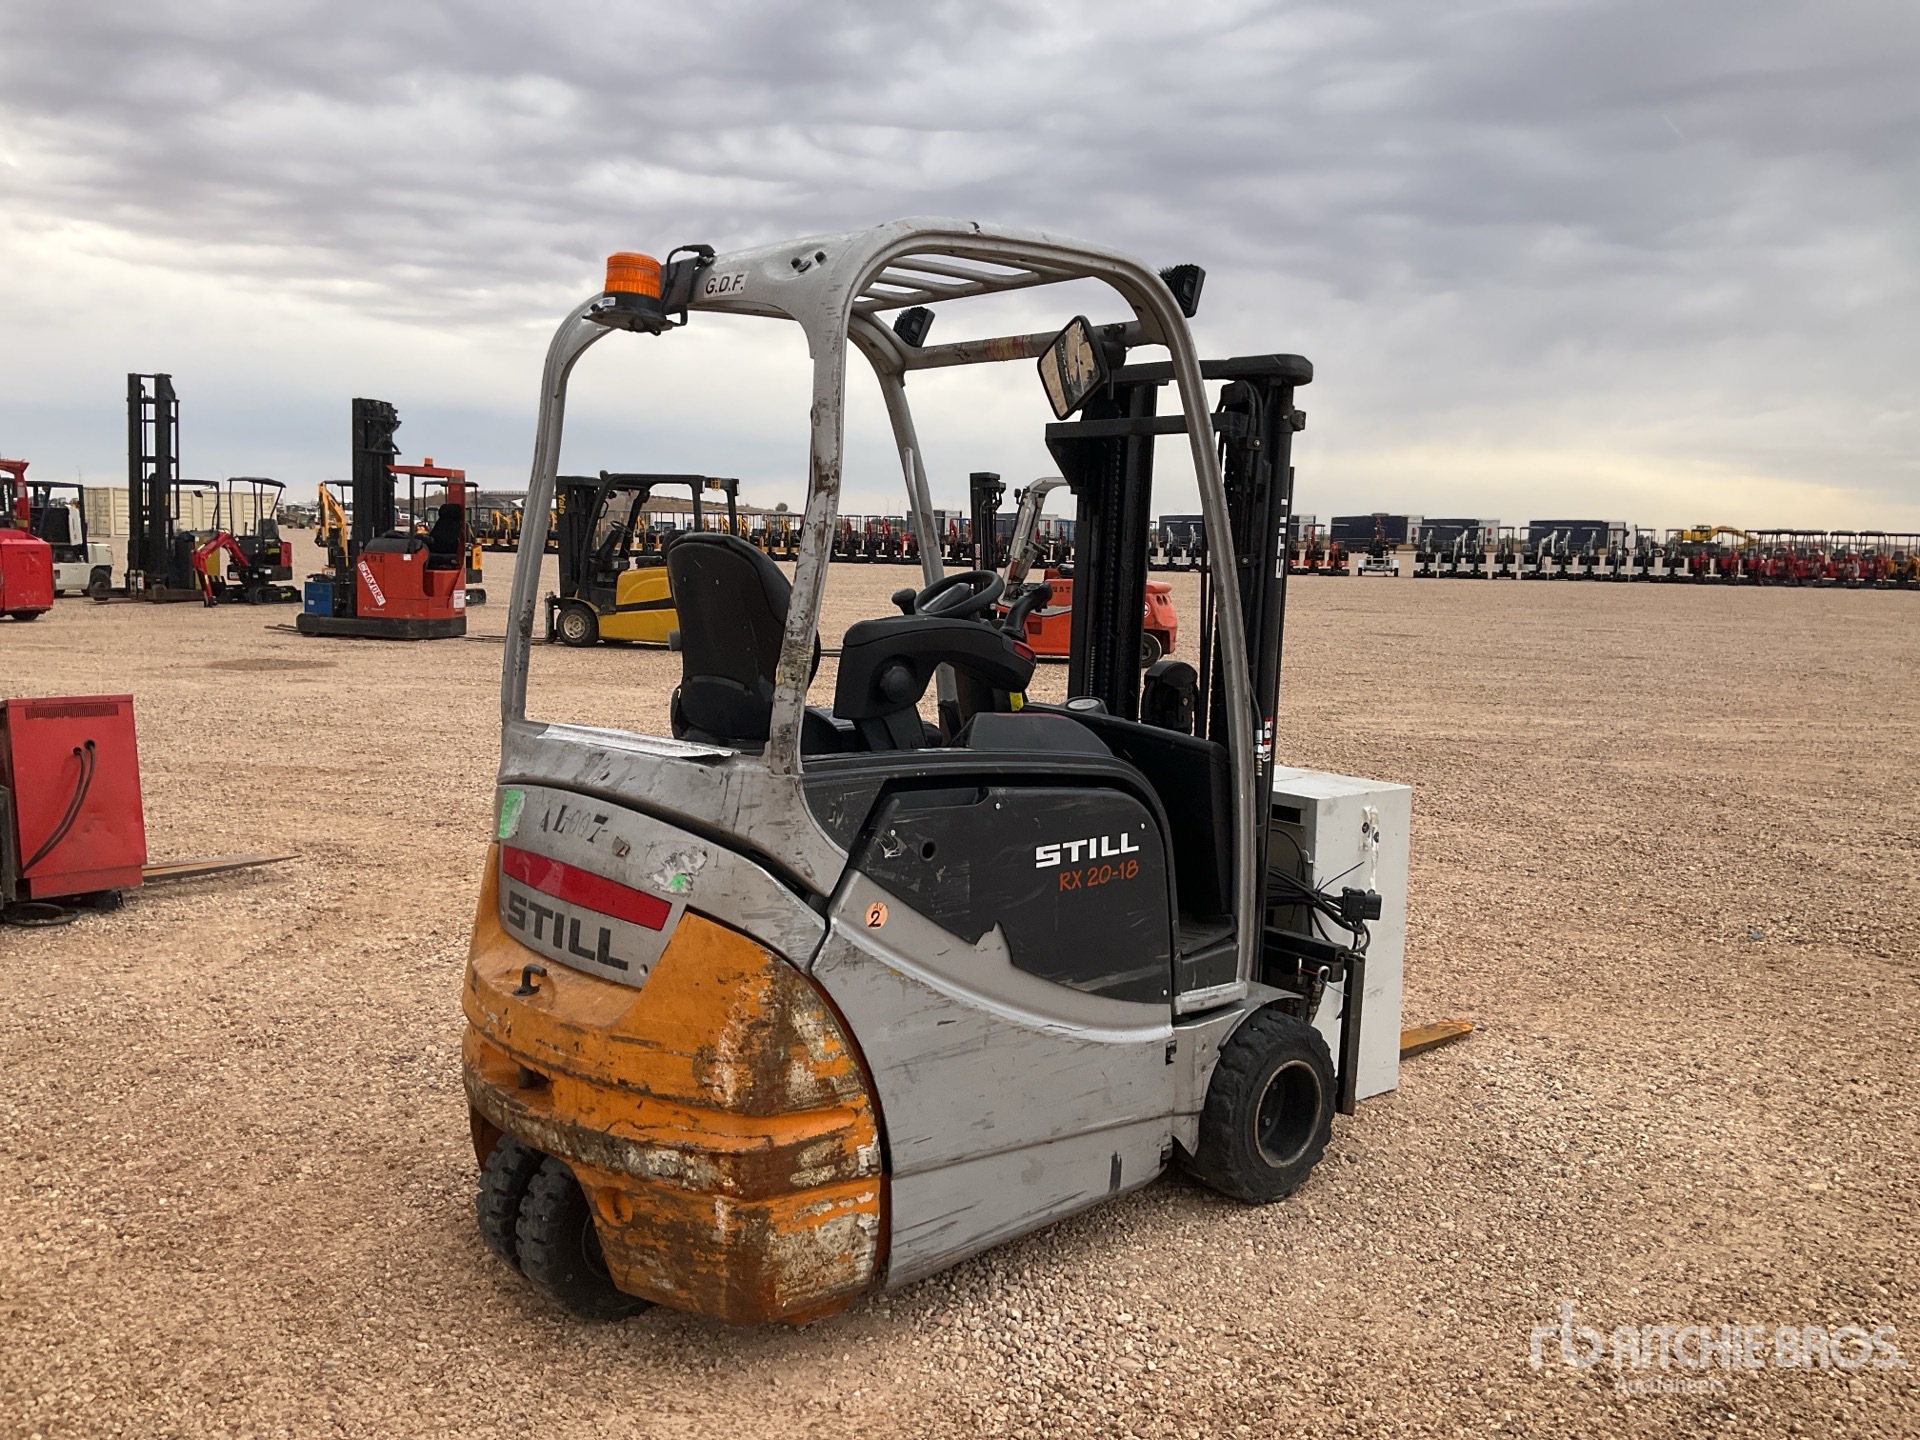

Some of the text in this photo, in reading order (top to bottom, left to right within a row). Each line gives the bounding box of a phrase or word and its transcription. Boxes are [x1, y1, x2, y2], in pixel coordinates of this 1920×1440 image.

[705, 274, 745, 295] G.D.F.
[557, 493, 567, 515] Yale
[1035, 832, 1140, 869] STILL
[1058, 859, 1140, 892] RX 20-18
[507, 889, 628, 971] STILL
[868, 910, 882, 928] 2
